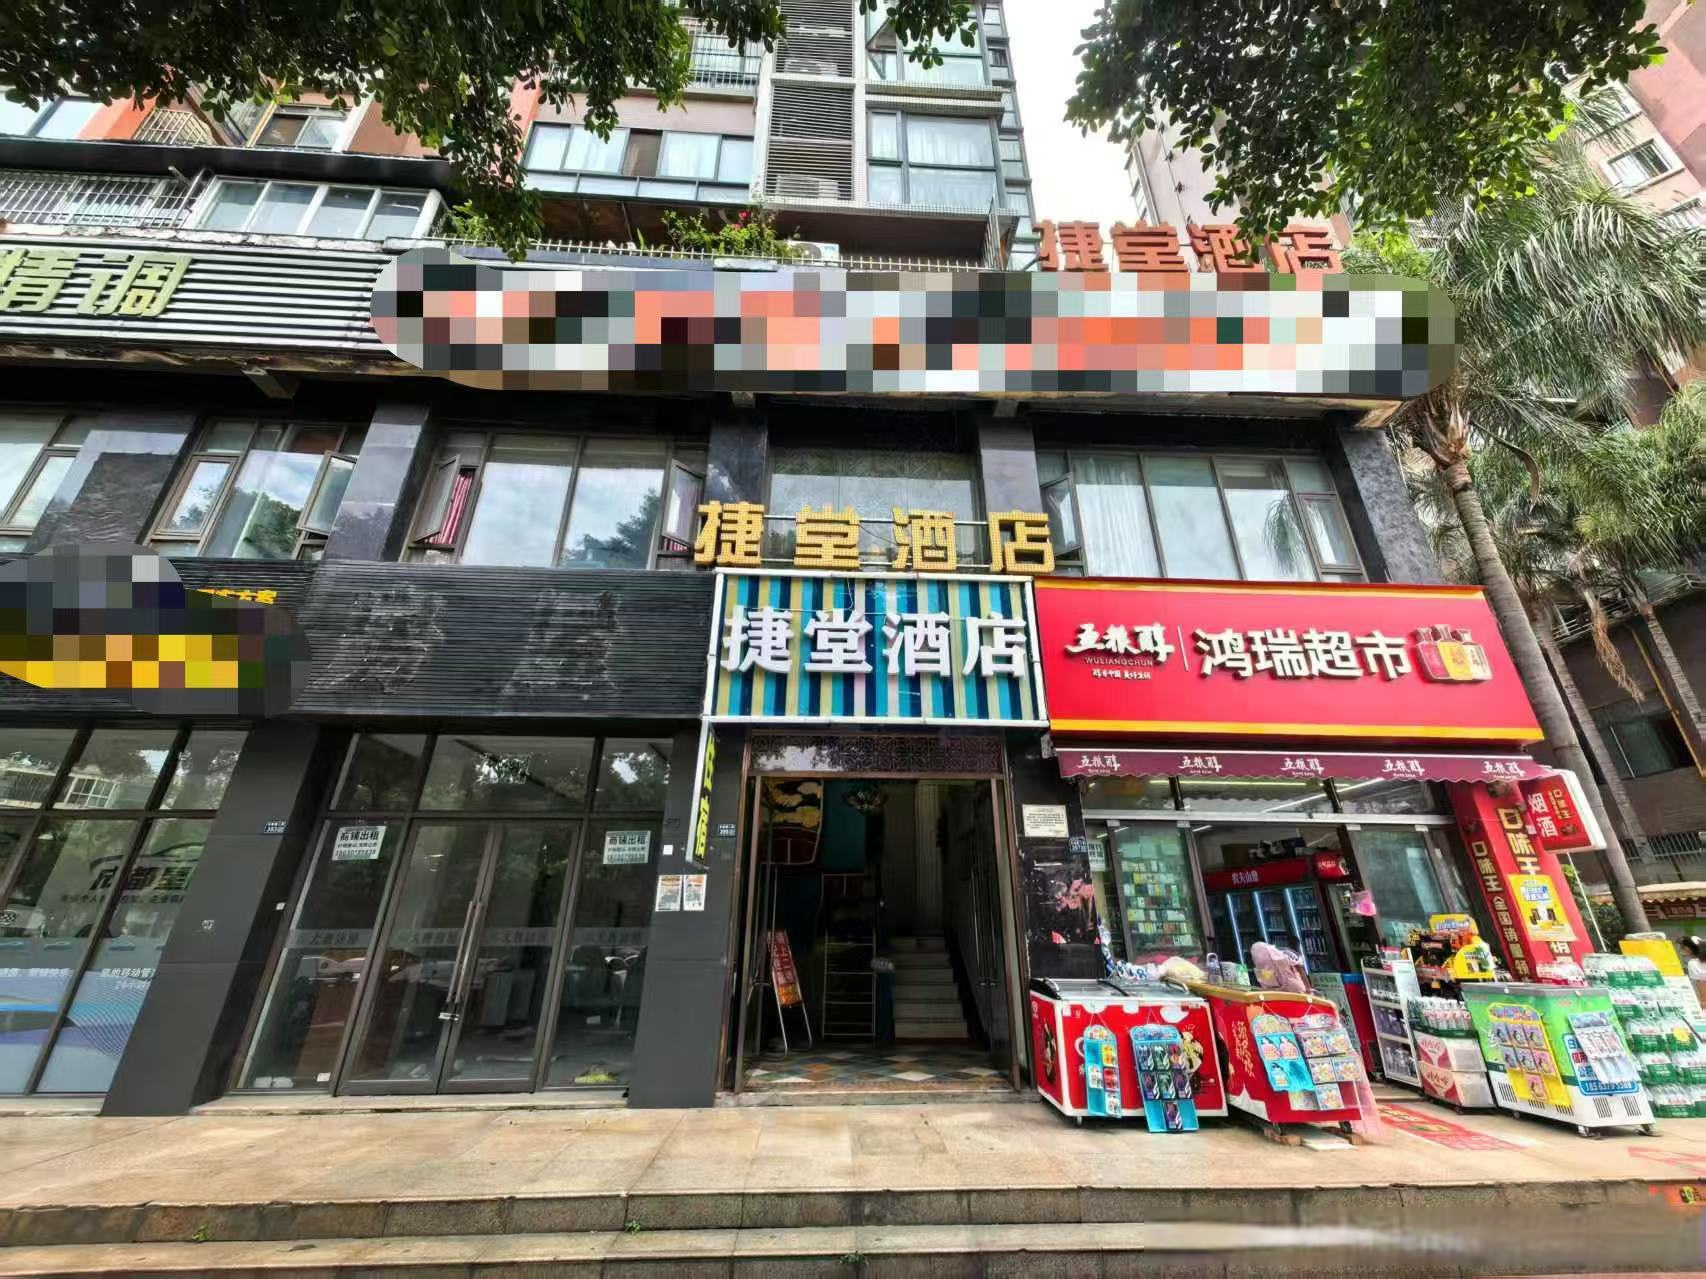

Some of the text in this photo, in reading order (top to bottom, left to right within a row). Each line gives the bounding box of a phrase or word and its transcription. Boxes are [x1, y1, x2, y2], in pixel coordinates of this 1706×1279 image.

[1034, 219, 1343, 273] 捷堂酒店
[693, 500, 1055, 574] 捷堂酒店
[720, 604, 1027, 678] 捷堂酒店
[1084, 655, 1154, 667] WULIANGCHUN
[1193, 627, 1411, 680] 鸿瑞超市
[1528, 792, 1559, 838] 烟酒
